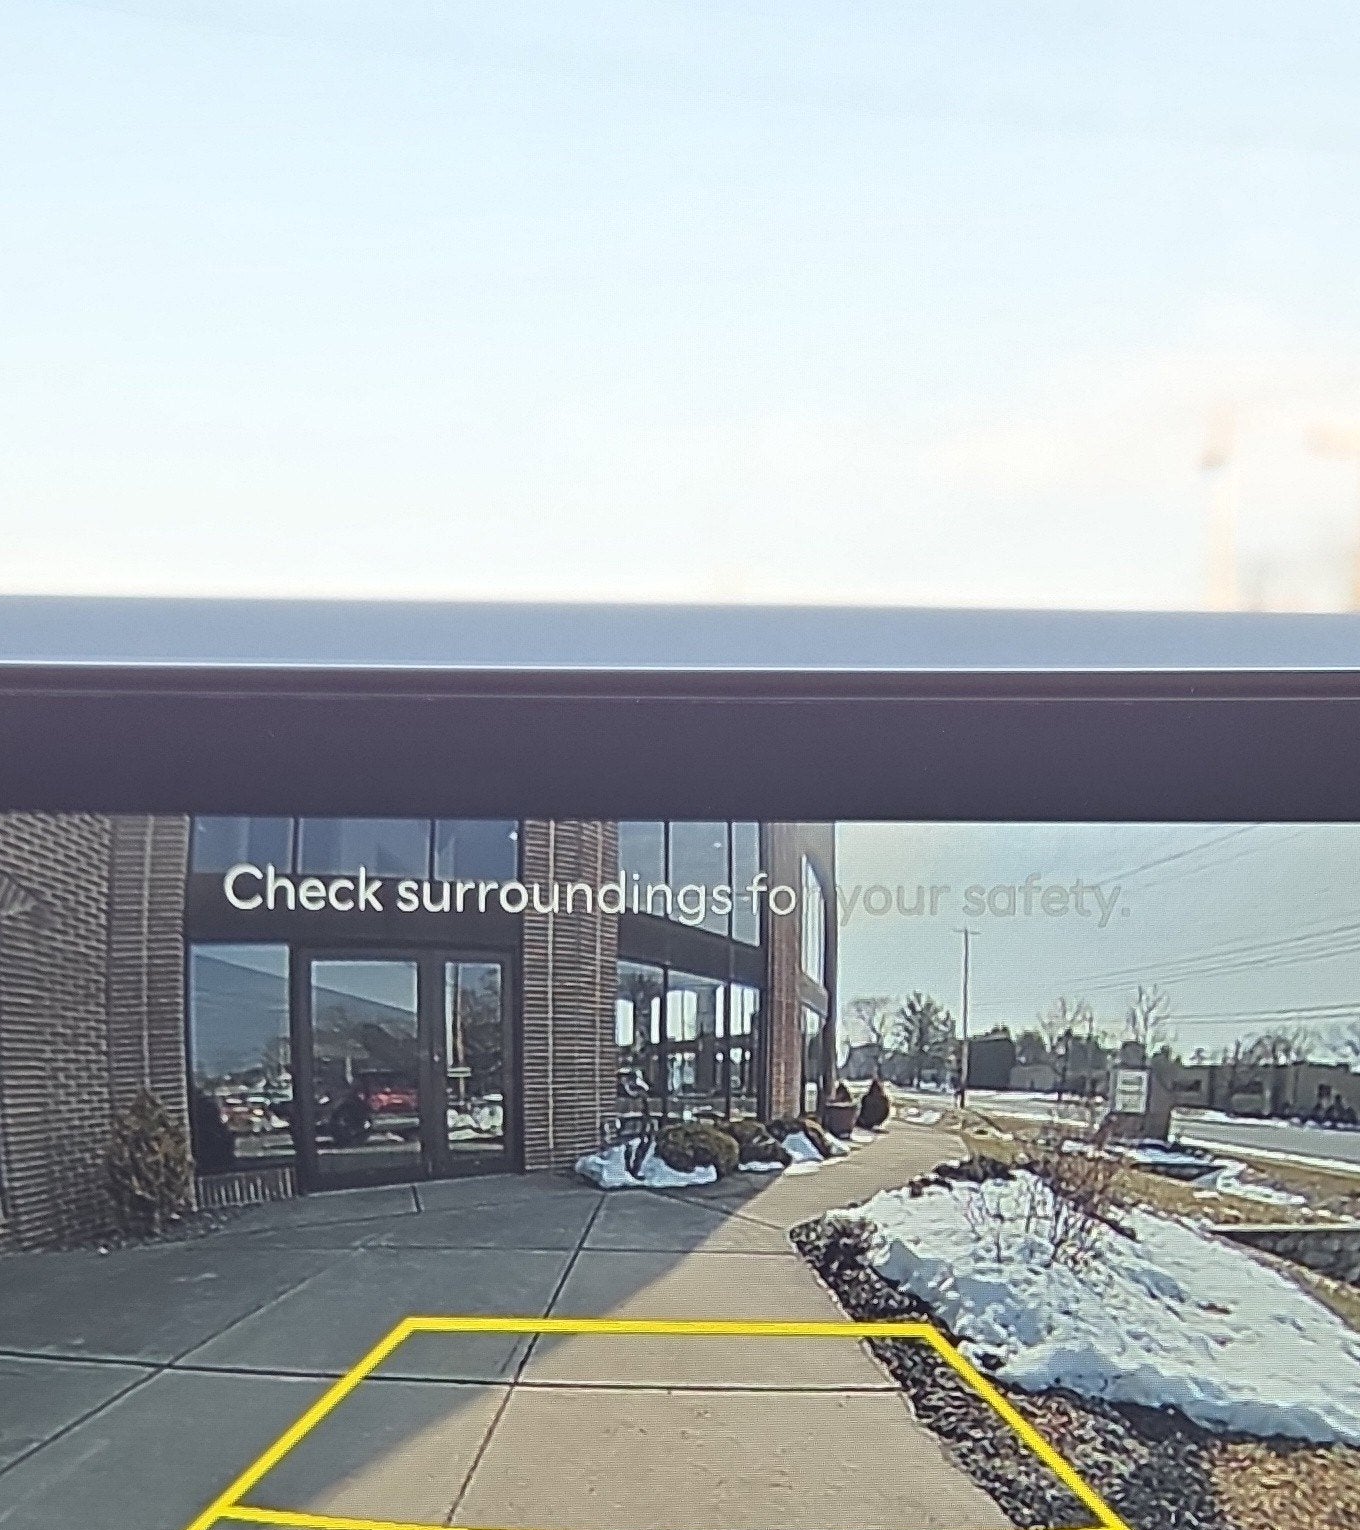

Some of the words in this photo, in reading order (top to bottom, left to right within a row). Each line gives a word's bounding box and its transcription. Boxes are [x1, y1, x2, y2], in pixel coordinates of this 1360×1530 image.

[222, 863, 384, 913] Check
[396, 869, 734, 926] surroundings
[837, 883, 951, 927] your
[962, 872, 1132, 928] safety.
